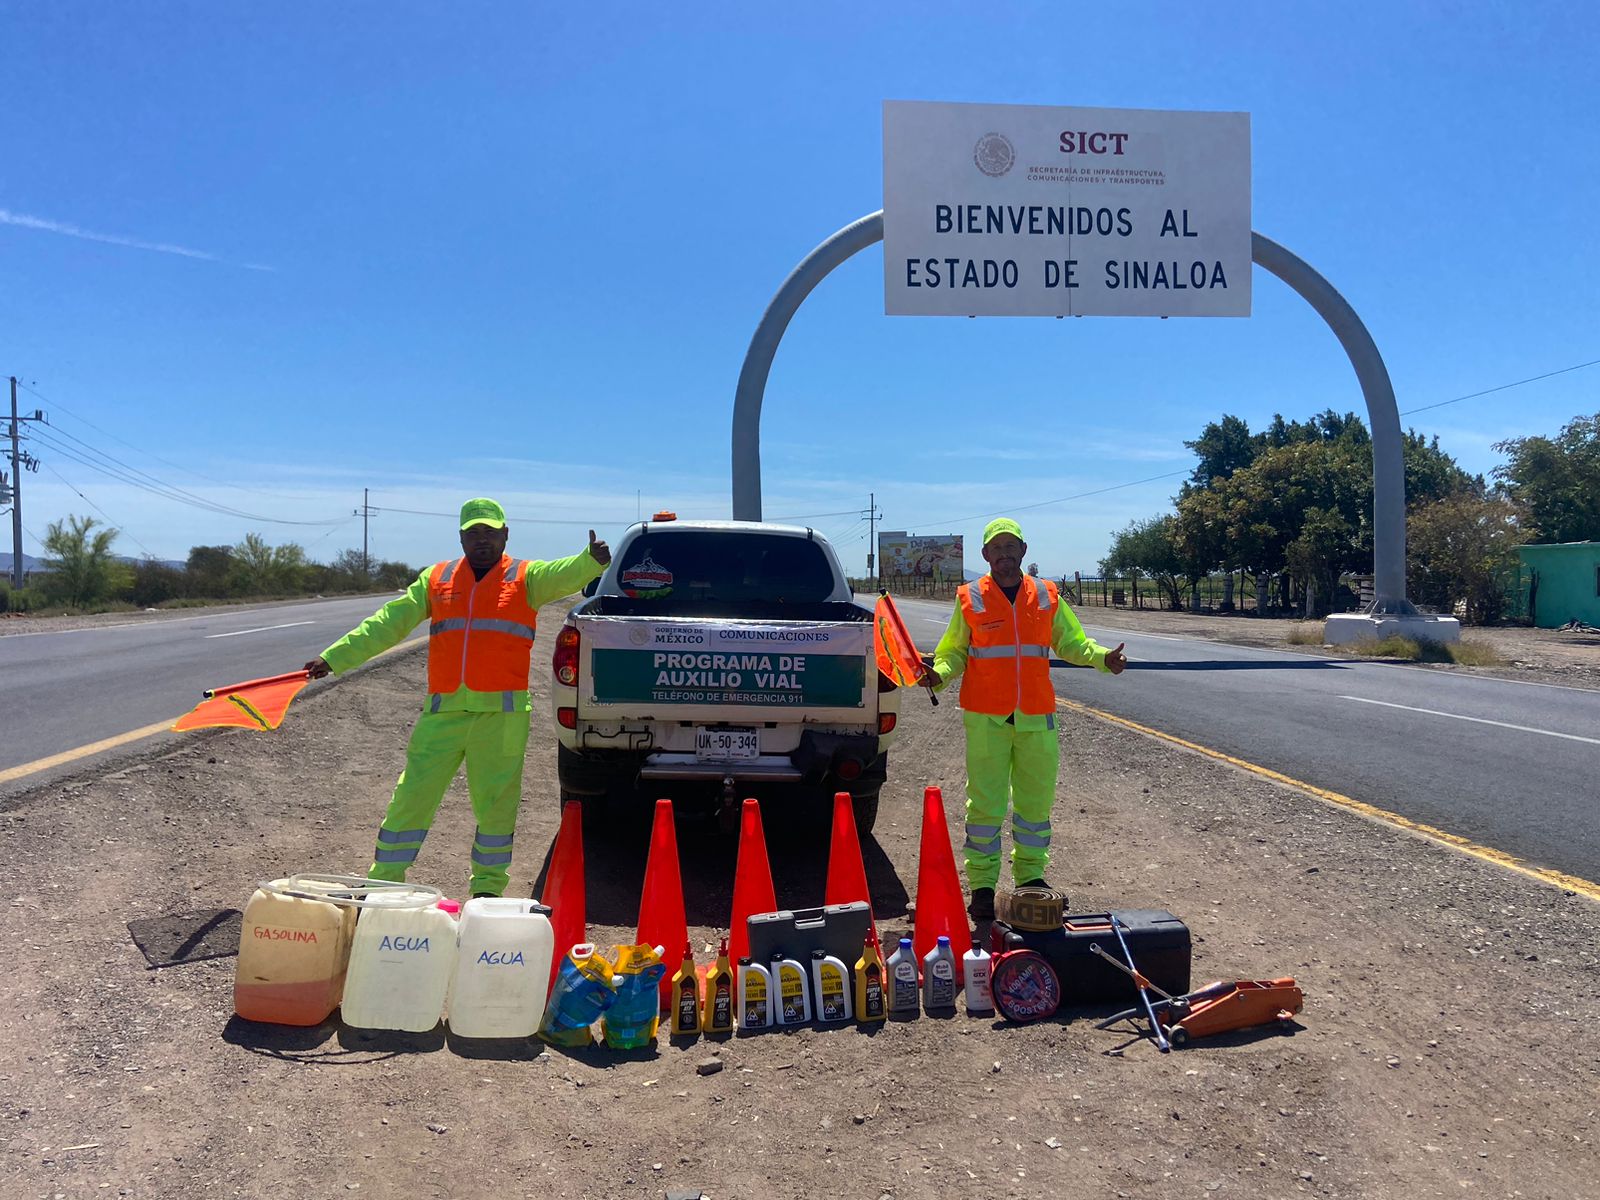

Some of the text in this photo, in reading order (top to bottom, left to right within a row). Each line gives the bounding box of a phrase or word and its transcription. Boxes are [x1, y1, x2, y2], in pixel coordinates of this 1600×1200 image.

[1059, 131, 1129, 155] SICT
[1027, 175, 1100, 184] COMUNICACIONES
[1109, 177, 1165, 186] TRANSPORTES
[936, 204, 1198, 237] BIENVENIDOS AL
[906, 258, 1228, 290] ESTADO DE SINALOA
[655, 627, 693, 635] GOBIERNO
[655, 632, 704, 645] MÉXICO
[719, 629, 829, 642] COMUNICACIONES
[654, 653, 806, 672] PROGRAMA DE
[655, 671, 802, 689] AUXILIO VIAL
[652, 690, 803, 704] TELÉFONO DE EMERGENCIA 911
[698, 734, 757, 750] UK-50-344
[253, 926, 318, 944] GASOLINA
[378, 935, 430, 953] AGUA
[477, 951, 525, 967] AGUA
[1040, 966, 1053, 998] CABLE
